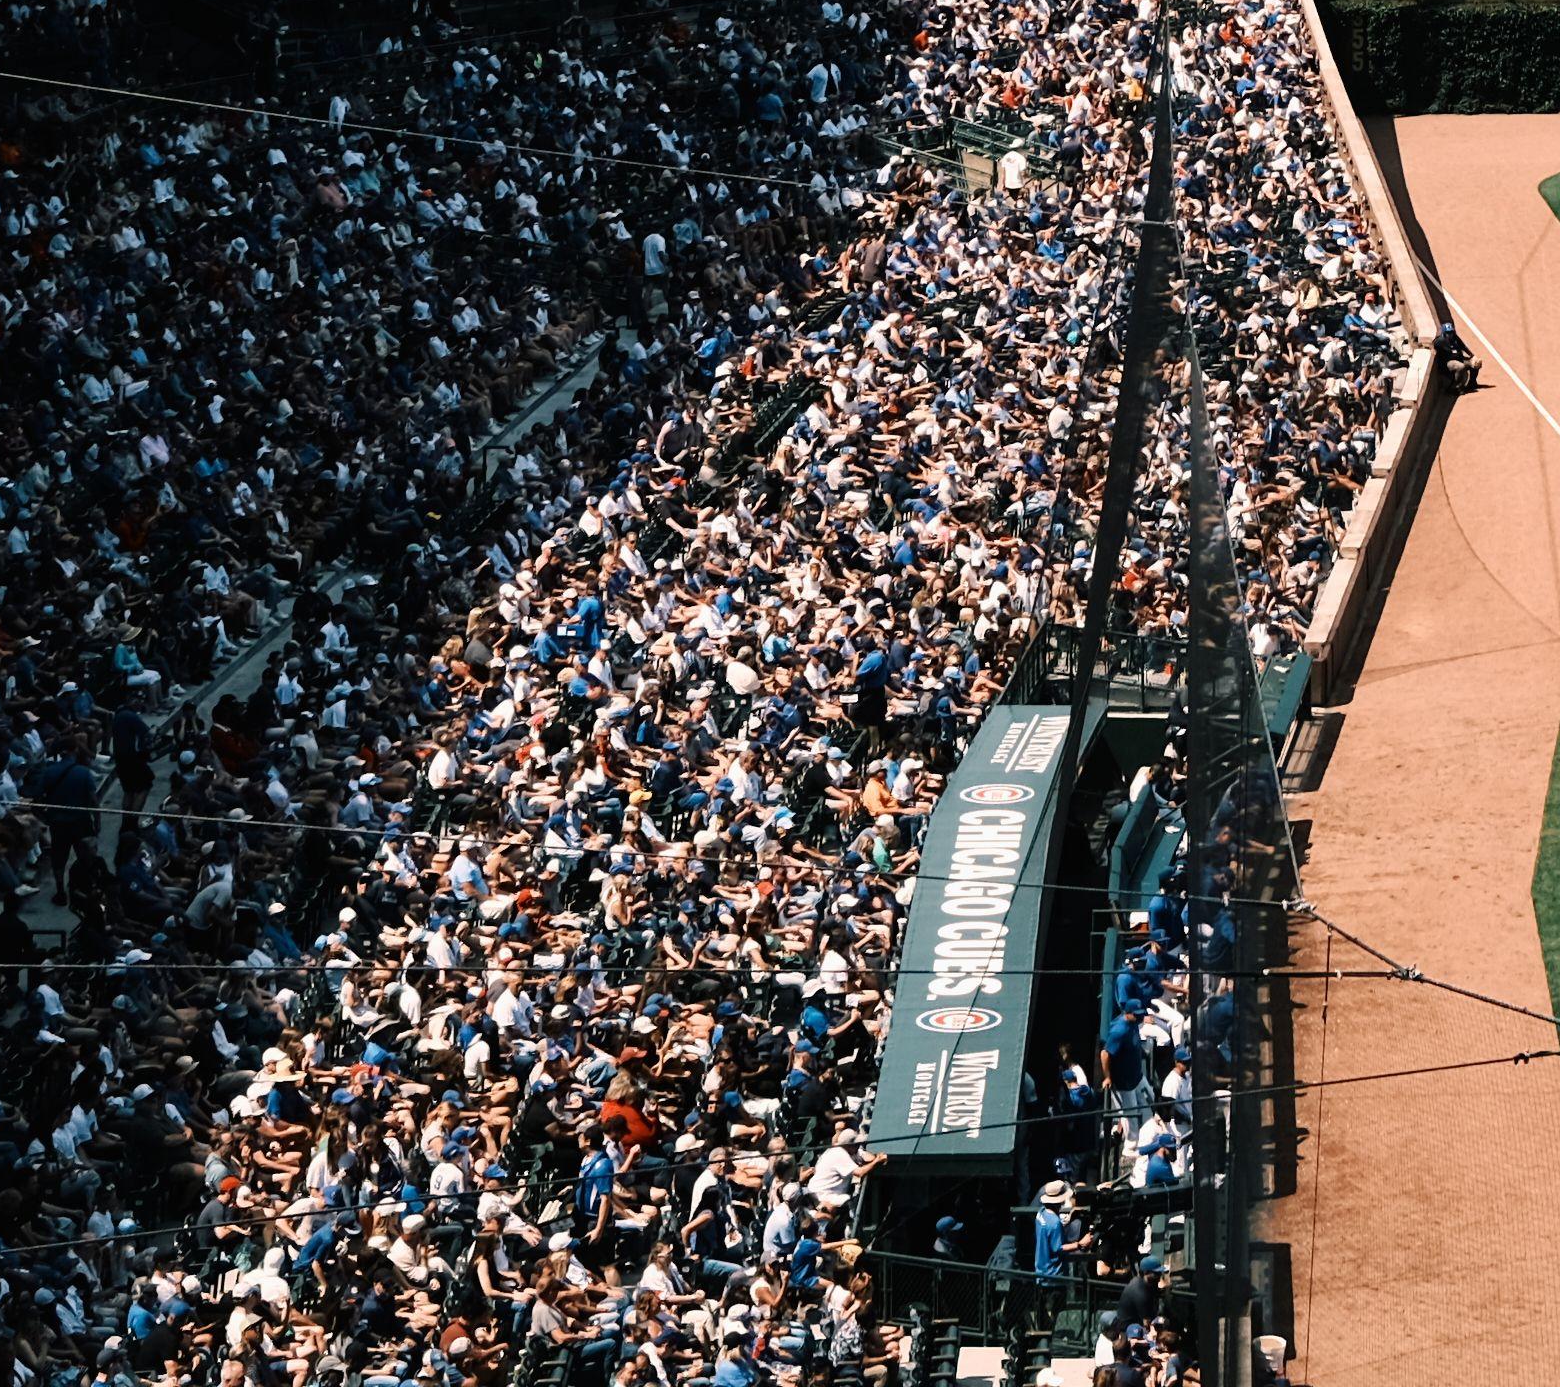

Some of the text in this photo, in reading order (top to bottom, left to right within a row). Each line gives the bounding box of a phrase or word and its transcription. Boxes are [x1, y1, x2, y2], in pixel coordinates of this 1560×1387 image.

[1015, 715, 1071, 773] WINTRUST
[927, 809, 1026, 997] CHICAGO CUBS
[907, 1062, 937, 1125] MORTGAGE
[941, 1049, 1000, 1139] WINTRUST
